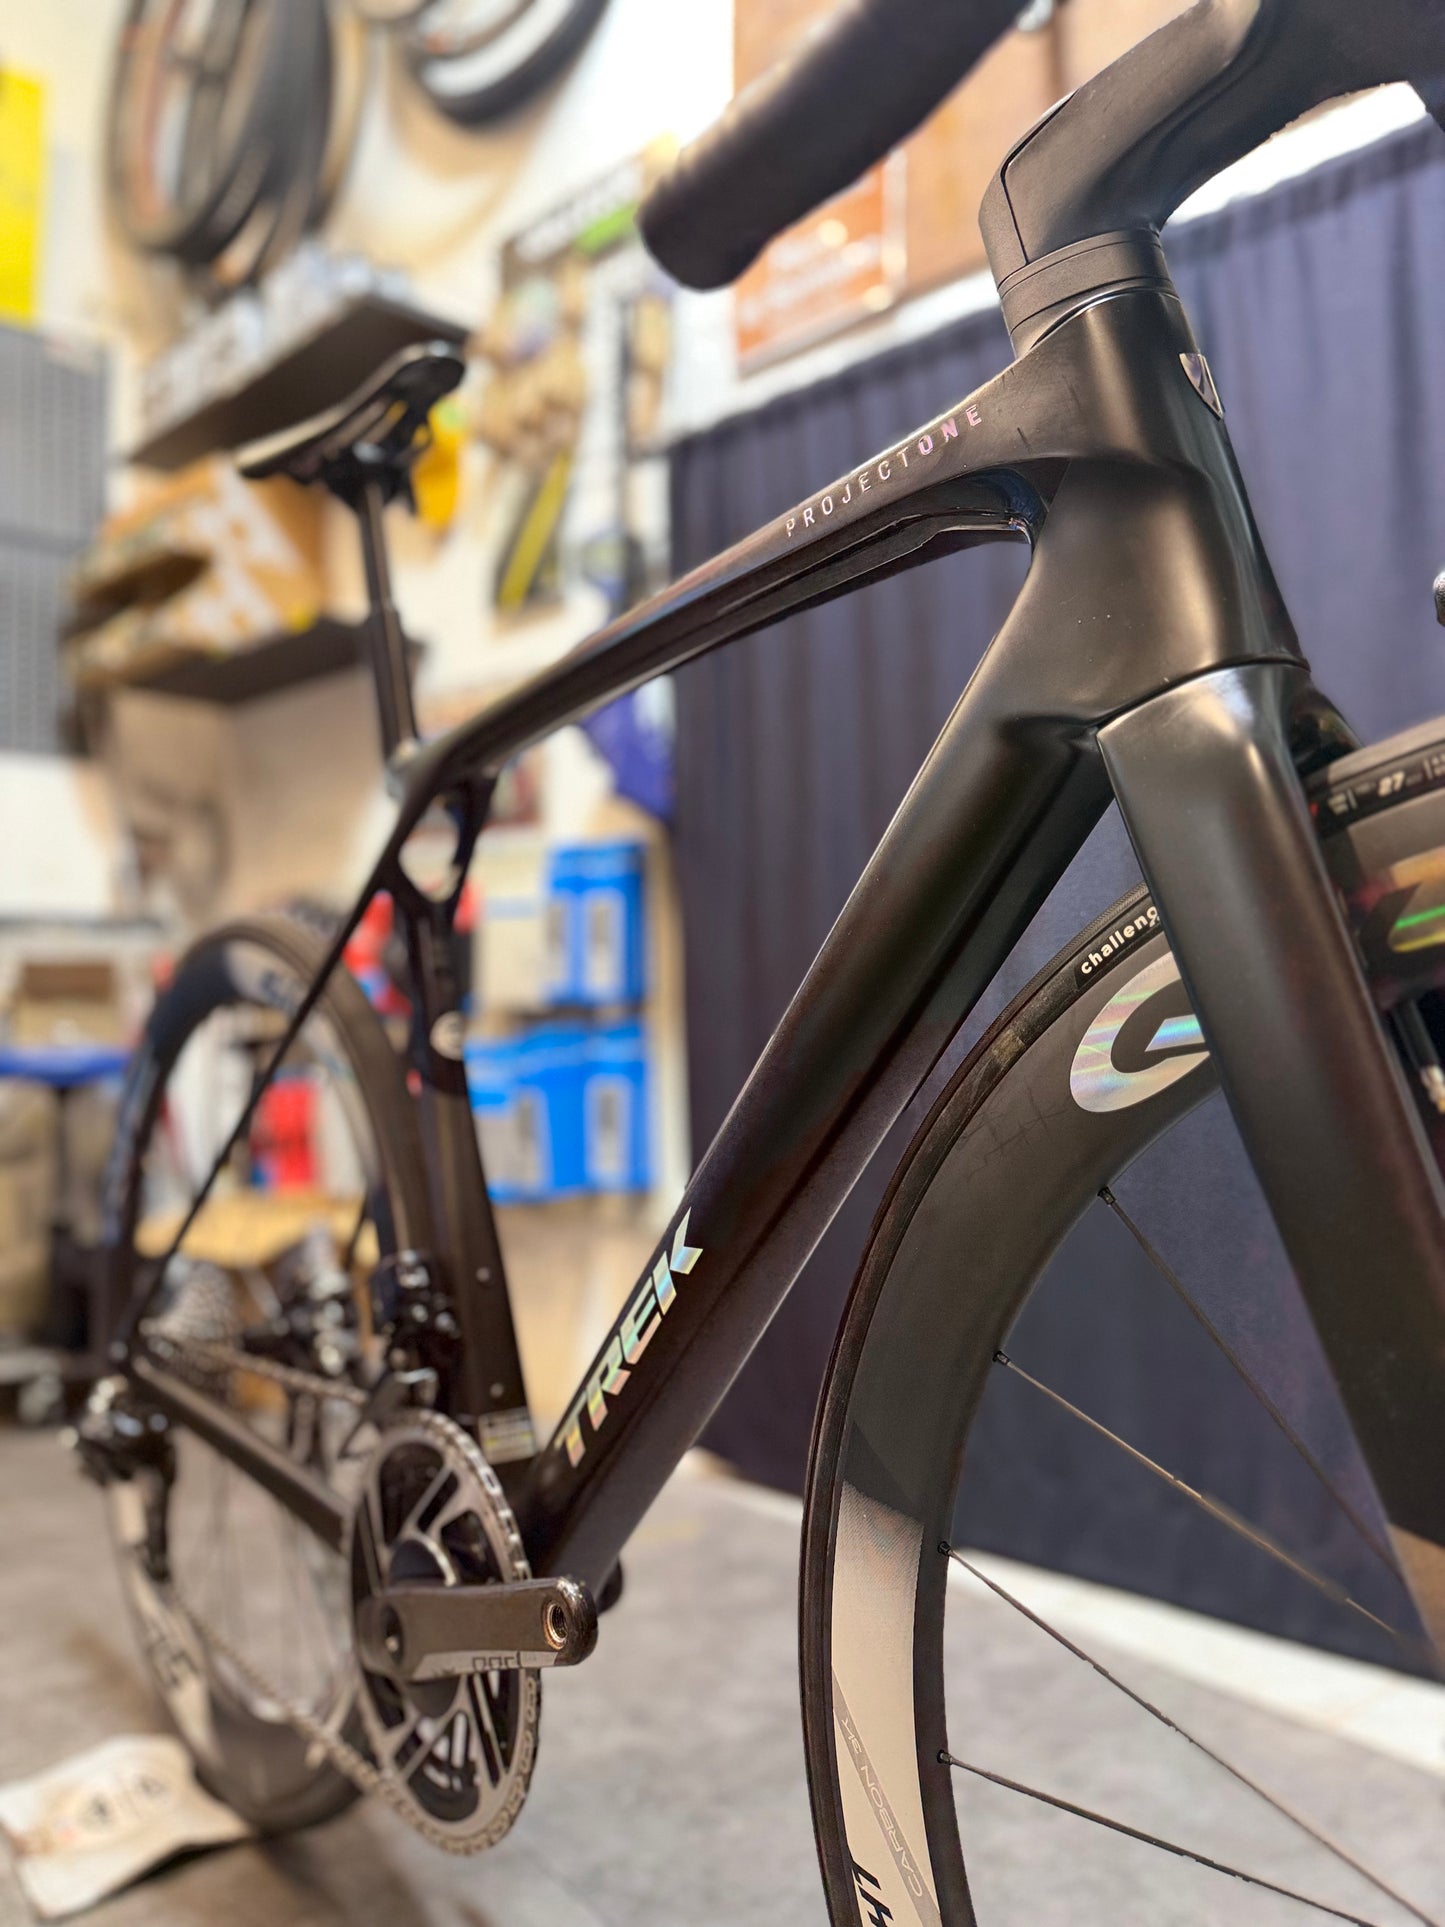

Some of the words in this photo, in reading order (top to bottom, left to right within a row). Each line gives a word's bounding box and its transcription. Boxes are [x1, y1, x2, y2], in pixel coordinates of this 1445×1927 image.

[1081, 905, 1161, 974] challeng
[554, 1206, 704, 1468] TREK
[860, 1764, 923, 1898] CARBON
